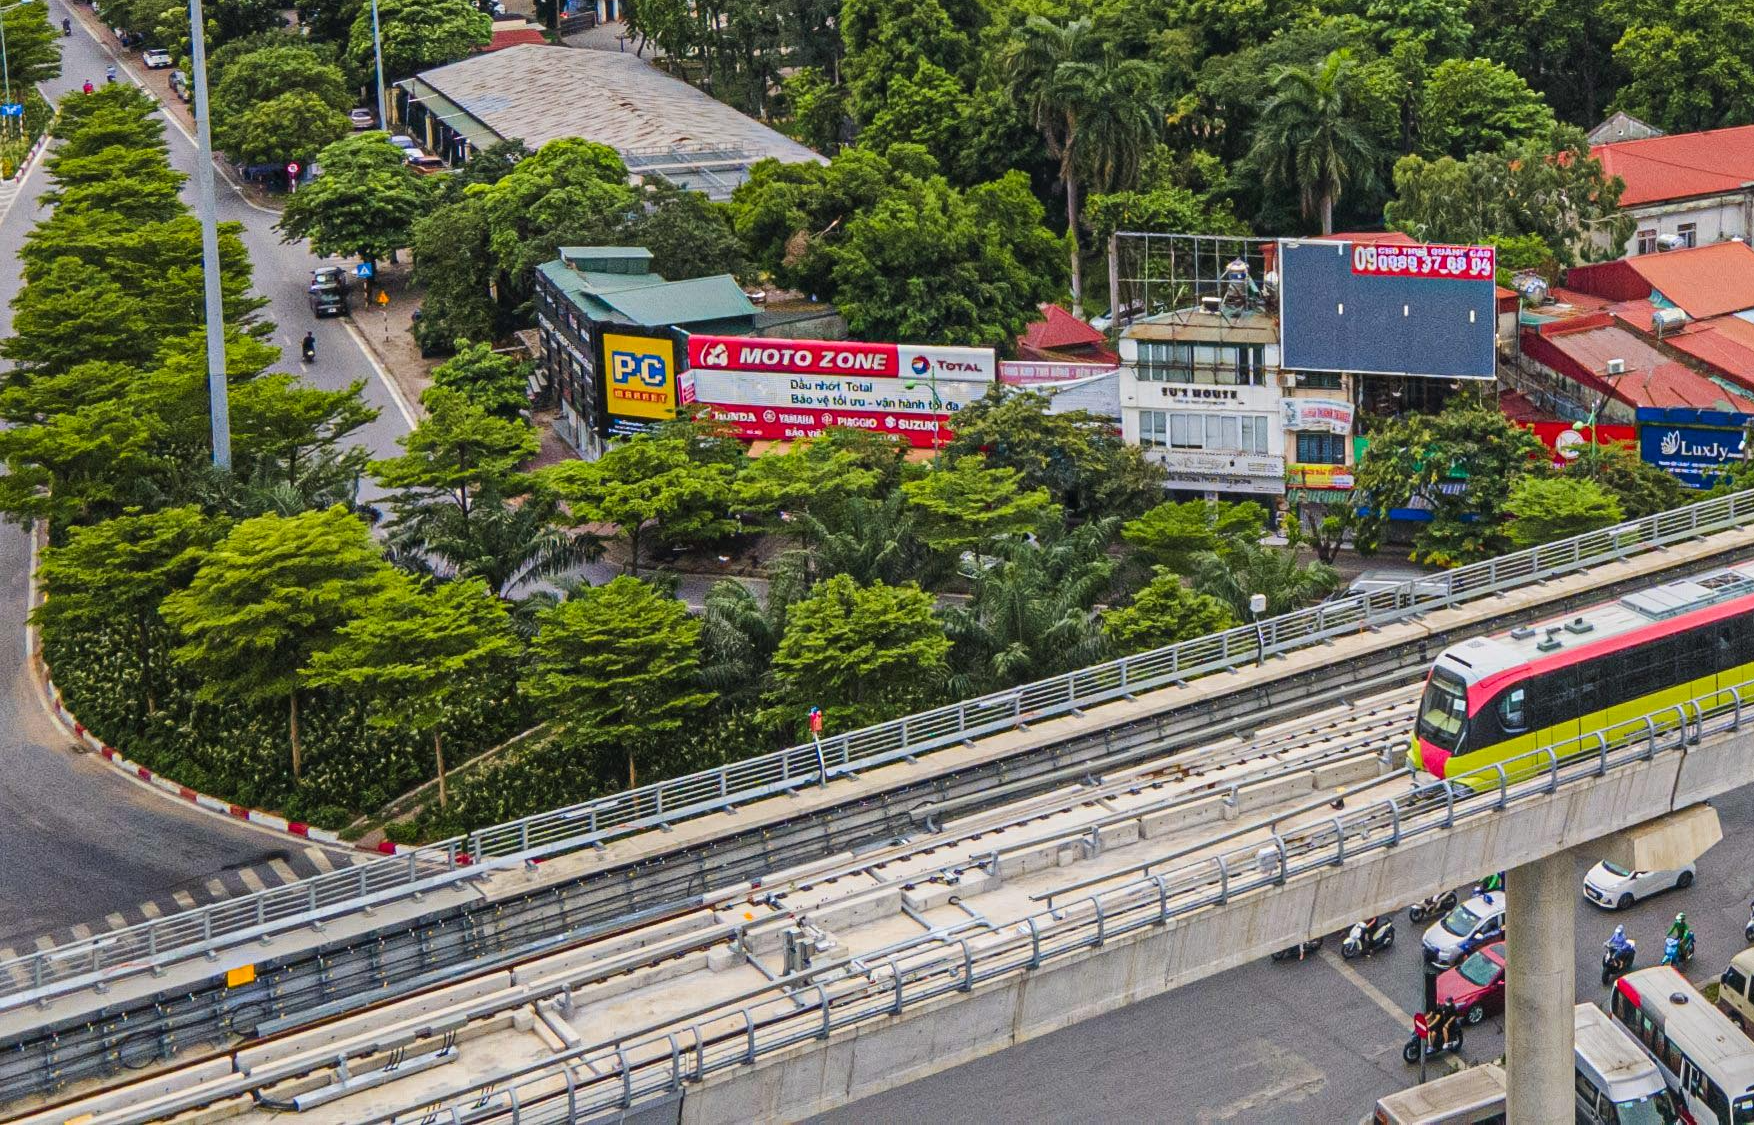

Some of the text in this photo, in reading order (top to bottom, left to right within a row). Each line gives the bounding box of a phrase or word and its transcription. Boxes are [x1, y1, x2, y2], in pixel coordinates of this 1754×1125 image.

[612, 352, 666, 386] PC
[740, 346, 888, 371] MOTO ZONE
[846, 381, 873, 393] Total
[779, 413, 815, 425] YAMAHA
[837, 416, 877, 428] PIAGGIO
[898, 419, 939, 431] SUZUKI
[1681, 440, 1729, 461] LuxJy
